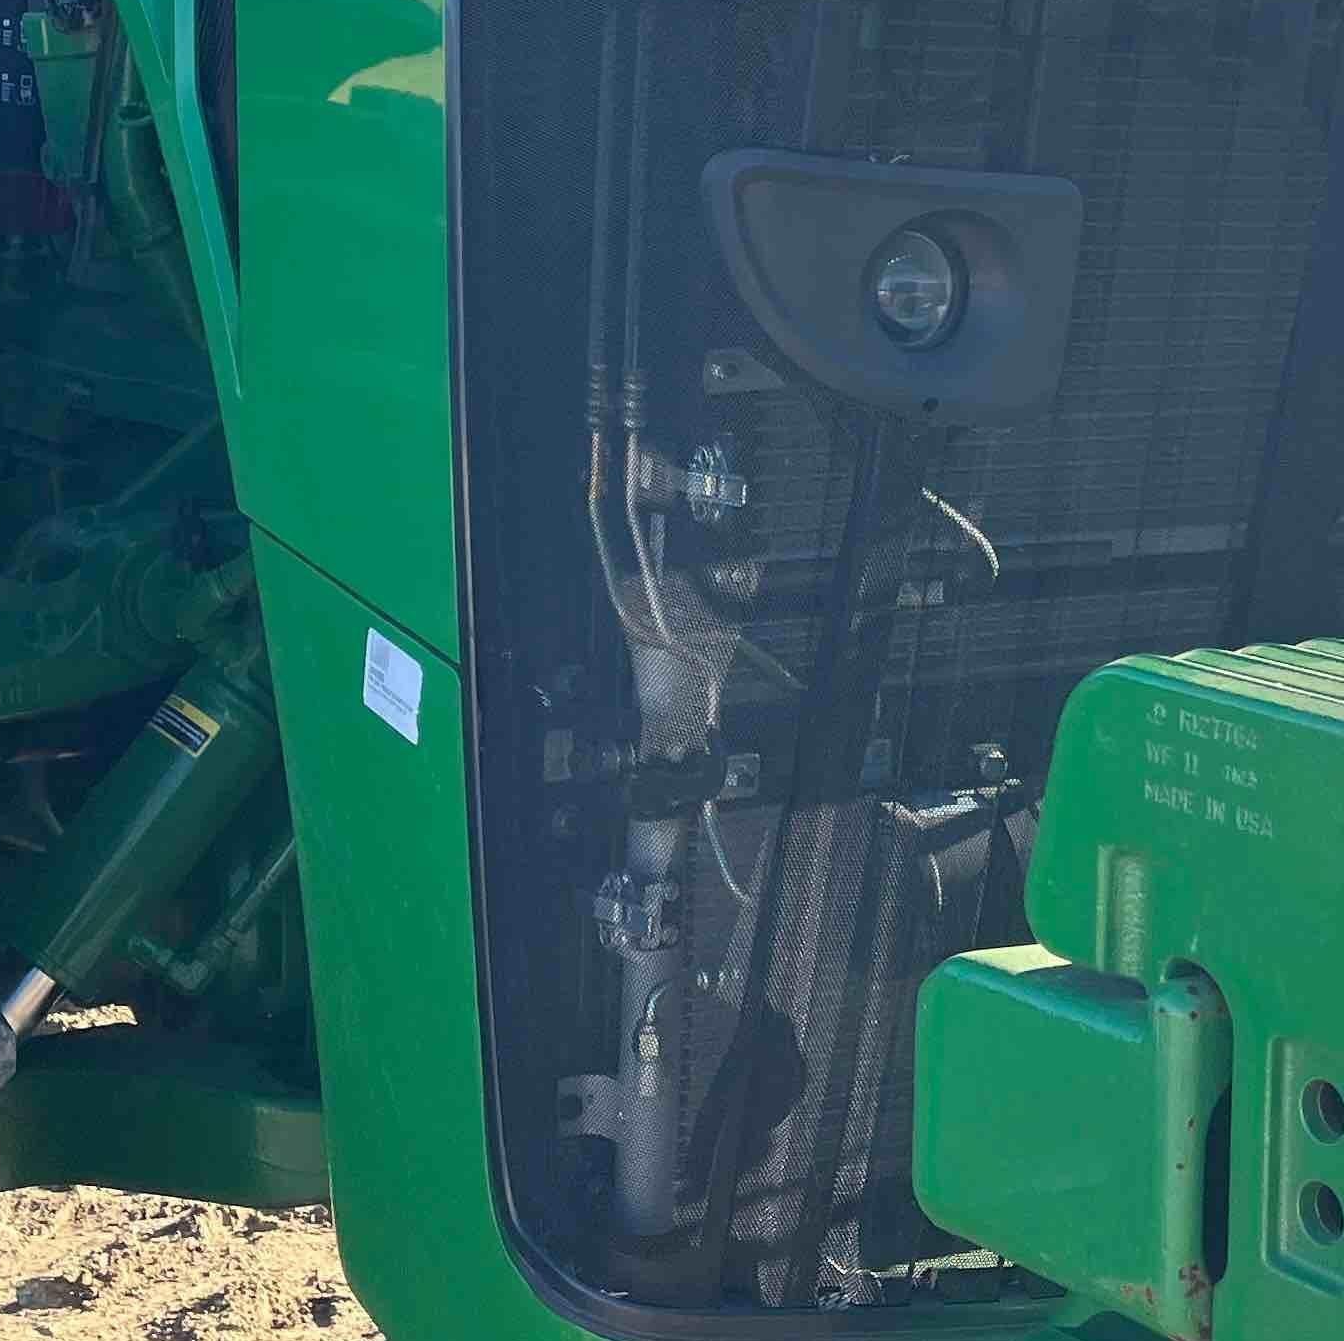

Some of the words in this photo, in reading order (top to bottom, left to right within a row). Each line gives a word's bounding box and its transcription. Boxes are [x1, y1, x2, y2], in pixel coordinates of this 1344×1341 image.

[1144, 779, 1194, 815] MADE
[1205, 795, 1226, 824] IN
[1236, 805, 1273, 839] USA
